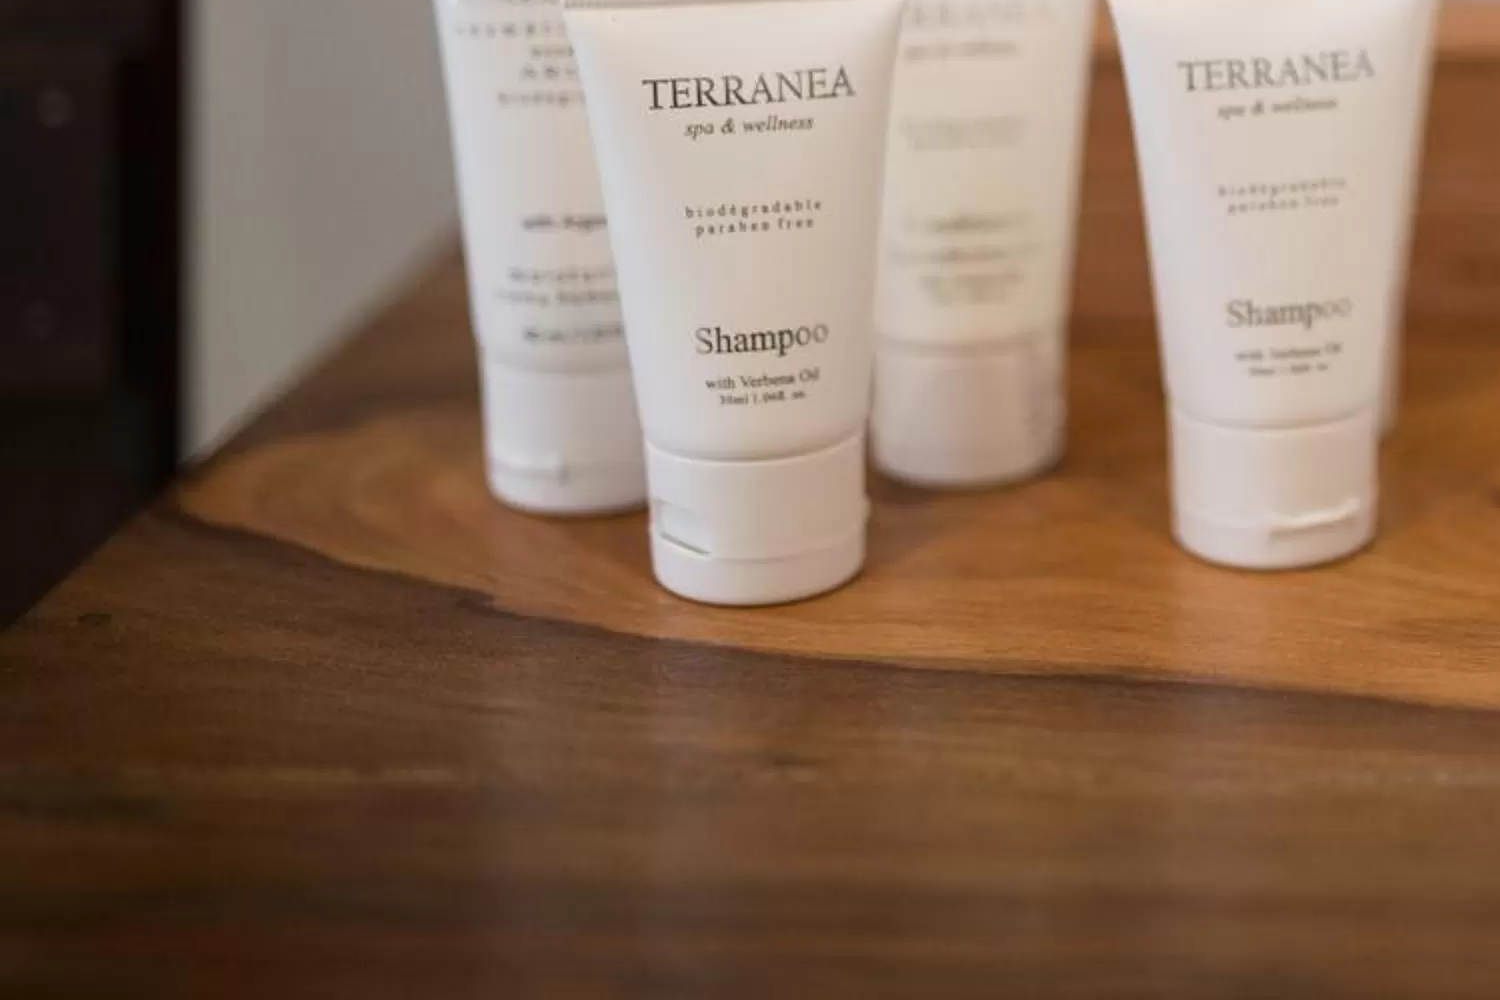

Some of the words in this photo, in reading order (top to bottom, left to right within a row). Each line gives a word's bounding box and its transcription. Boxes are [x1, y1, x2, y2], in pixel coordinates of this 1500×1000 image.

[1176, 48, 1376, 92] TERRANEA
[641, 65, 857, 110] TERRANEA
[684, 120, 715, 140] spa
[721, 116, 736, 135] &
[742, 114, 814, 133] wellness
[695, 221, 770, 239] paraben
[777, 217, 814, 231] free
[1225, 298, 1353, 329] Shampoo
[695, 323, 830, 357] Shampoo
[705, 376, 736, 389] with
